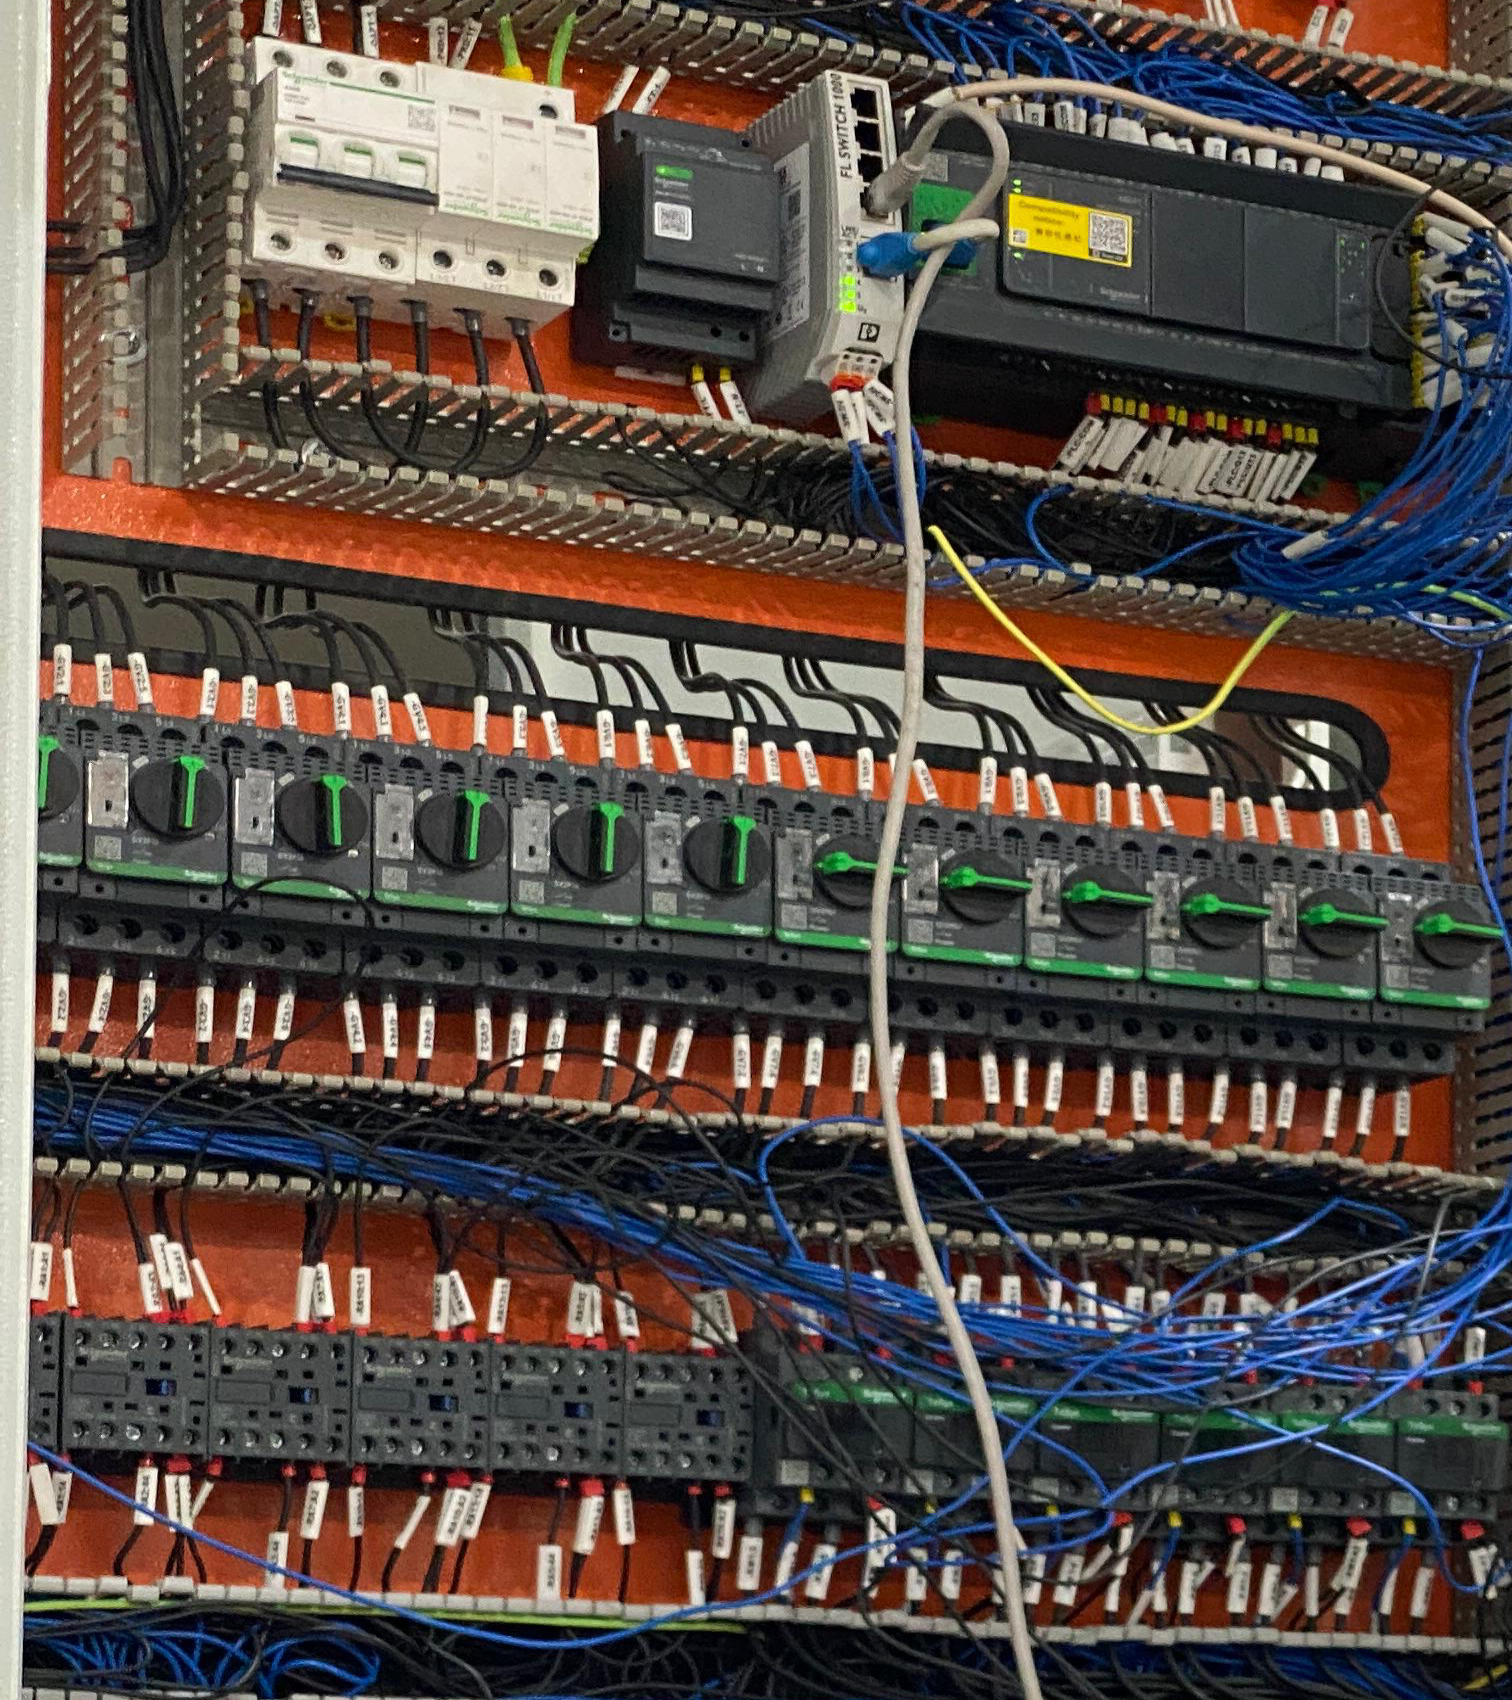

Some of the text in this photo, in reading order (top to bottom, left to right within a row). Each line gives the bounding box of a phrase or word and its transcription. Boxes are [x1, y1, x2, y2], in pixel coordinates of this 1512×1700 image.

[830, 73, 852, 178] FL SWITCH 1000
